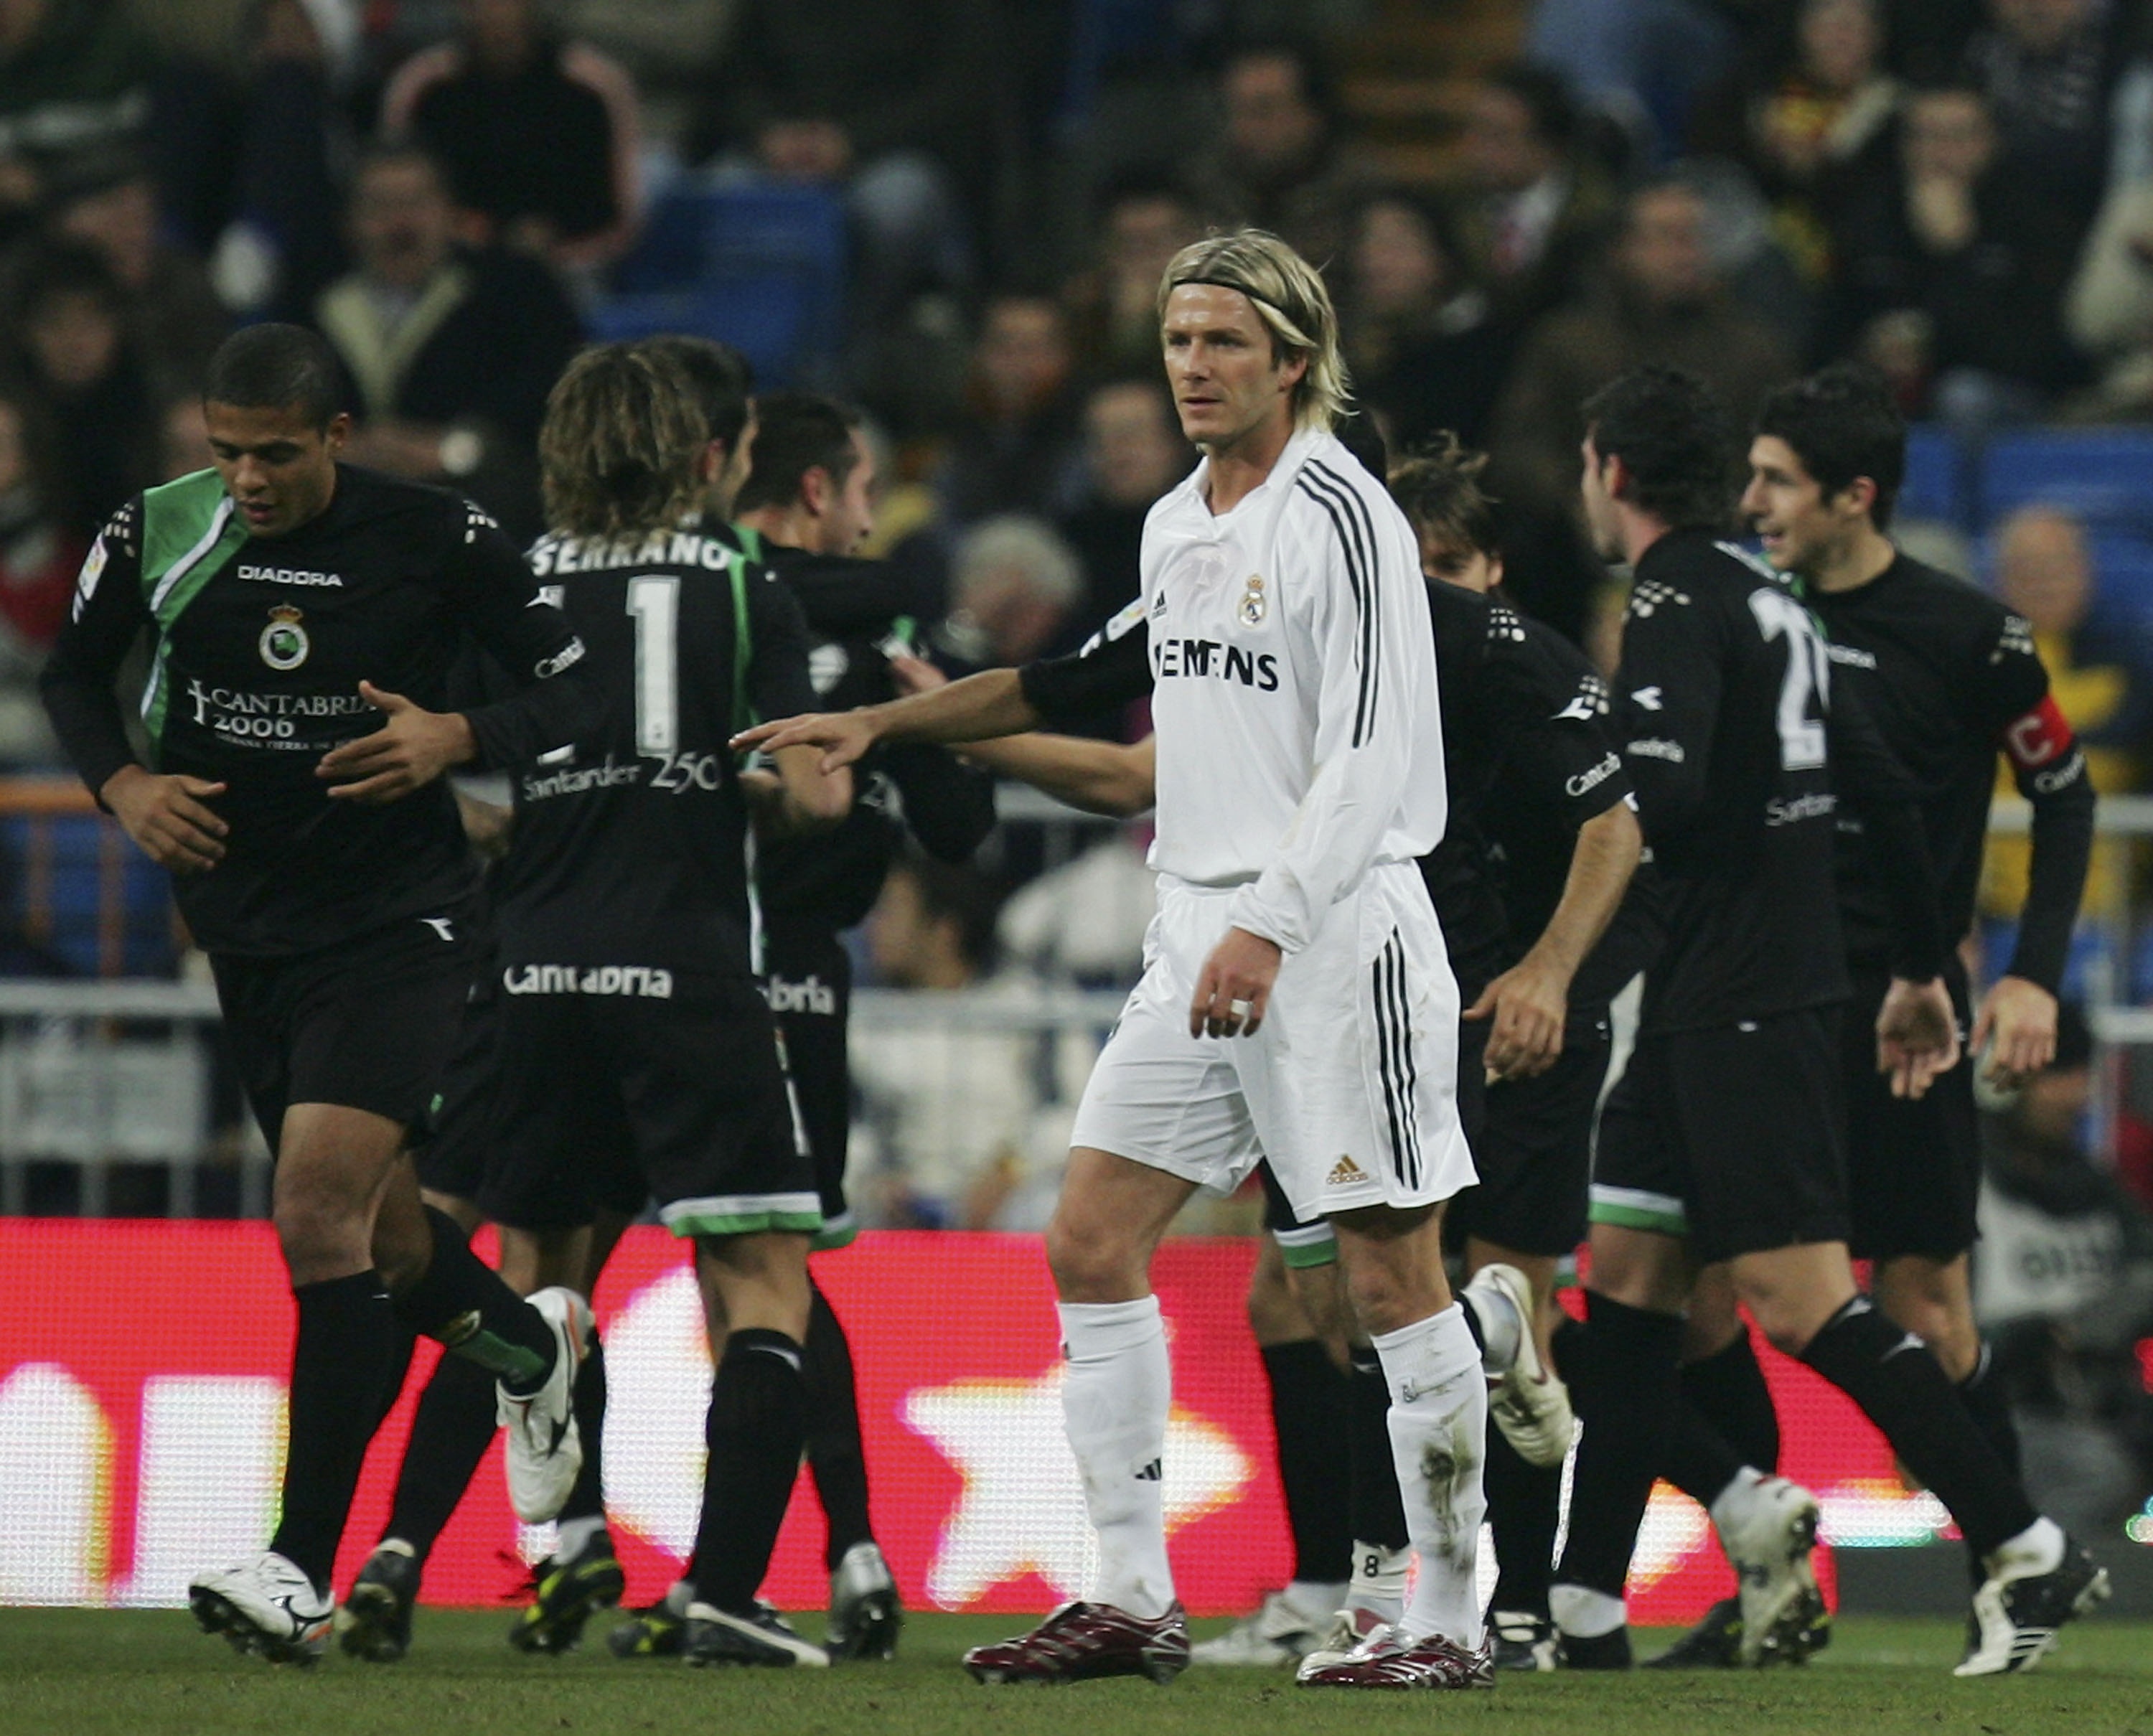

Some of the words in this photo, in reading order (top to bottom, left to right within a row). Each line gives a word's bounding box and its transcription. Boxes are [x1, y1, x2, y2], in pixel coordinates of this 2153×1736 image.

[238, 565, 343, 587] DIADORA
[626, 574, 681, 758] 1
[214, 713, 295, 738] 2006
[2009, 715, 2054, 765] C
[648, 751, 720, 795] 250
[1364, 1554, 1379, 1578] 8
